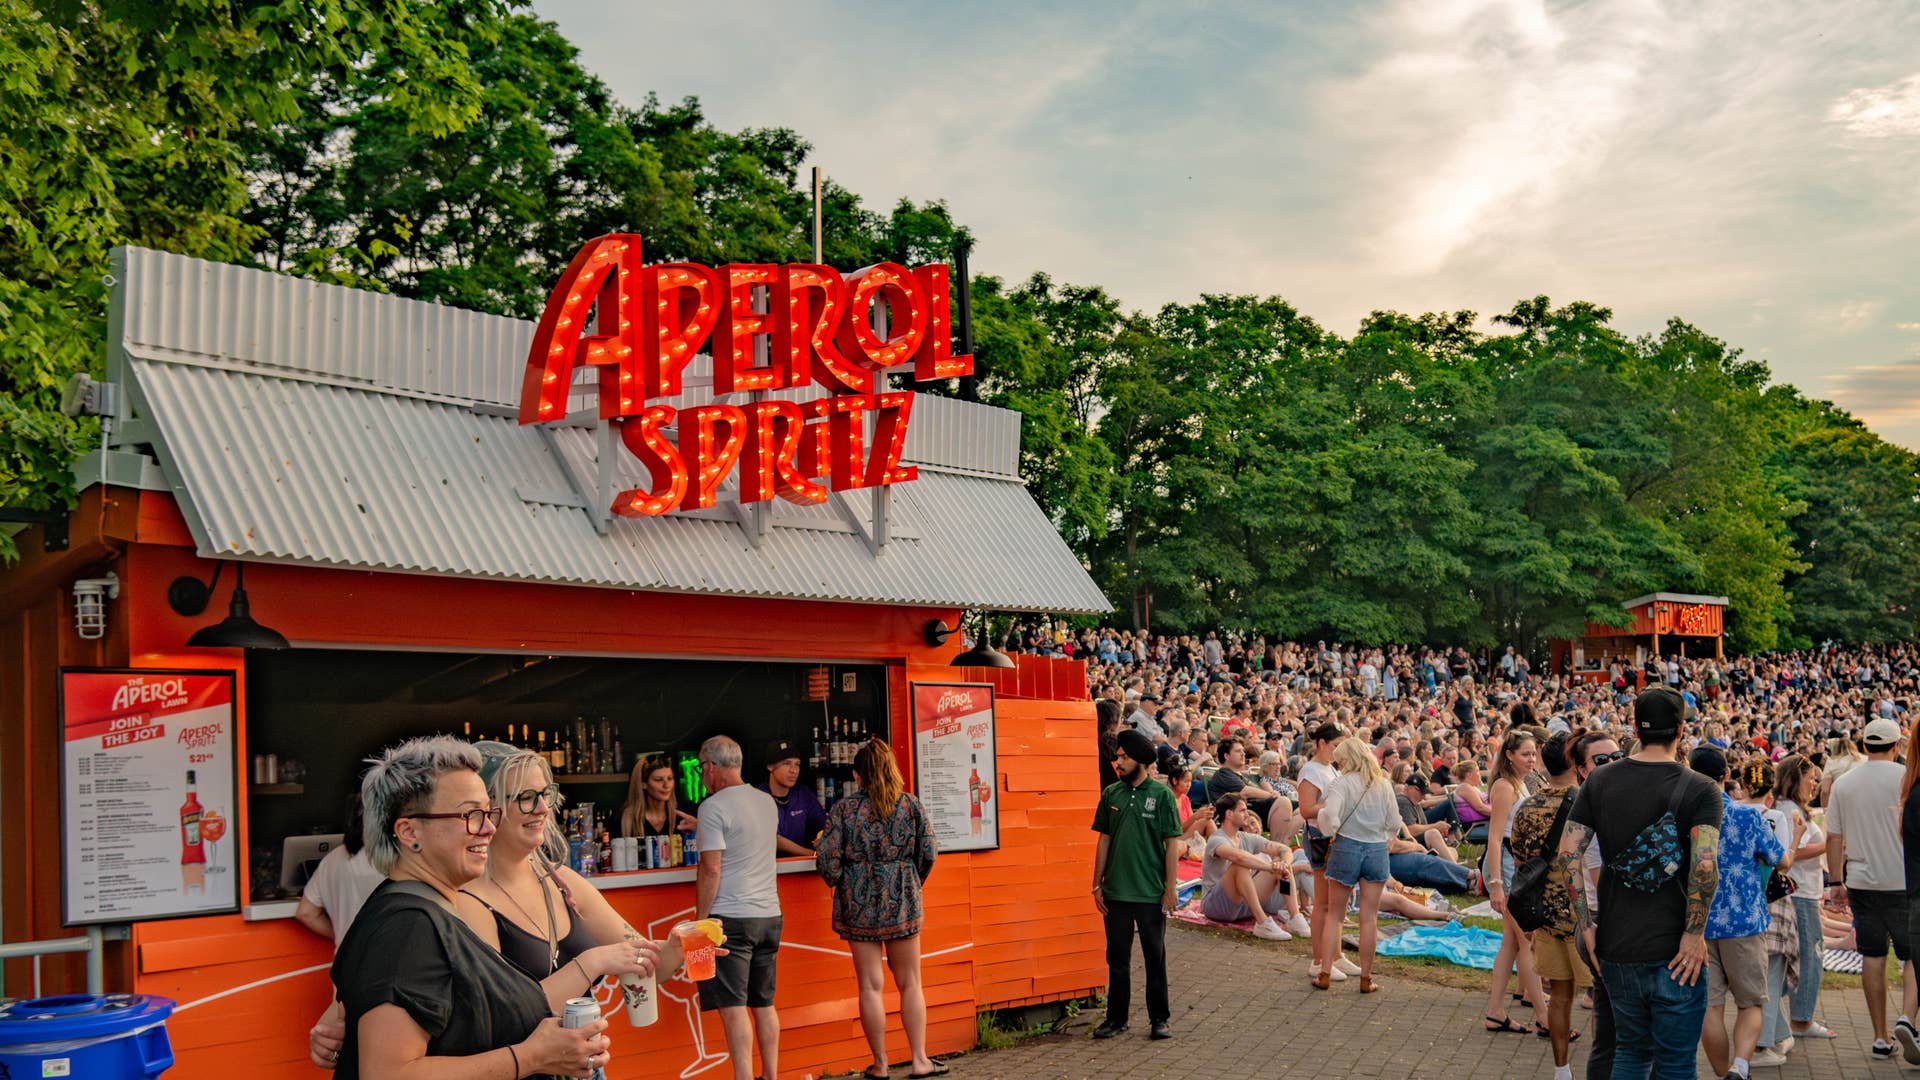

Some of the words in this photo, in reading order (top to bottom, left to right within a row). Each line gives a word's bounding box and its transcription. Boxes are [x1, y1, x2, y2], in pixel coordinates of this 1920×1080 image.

[519, 233, 974, 425] APEROL
[127, 677, 144, 687] THE
[112, 678, 188, 711] APEROL
[161, 697, 188, 708] LAWN
[937, 691, 972, 713] APEROL
[109, 715, 142, 731] JOIN
[934, 727, 946, 736] THE
[947, 724, 959, 733] JOY
[936, 716, 952, 726] JOIN
[105, 732, 129, 747] THE
[133, 726, 159, 741] JOY
[176, 723, 224, 744] APEROL
